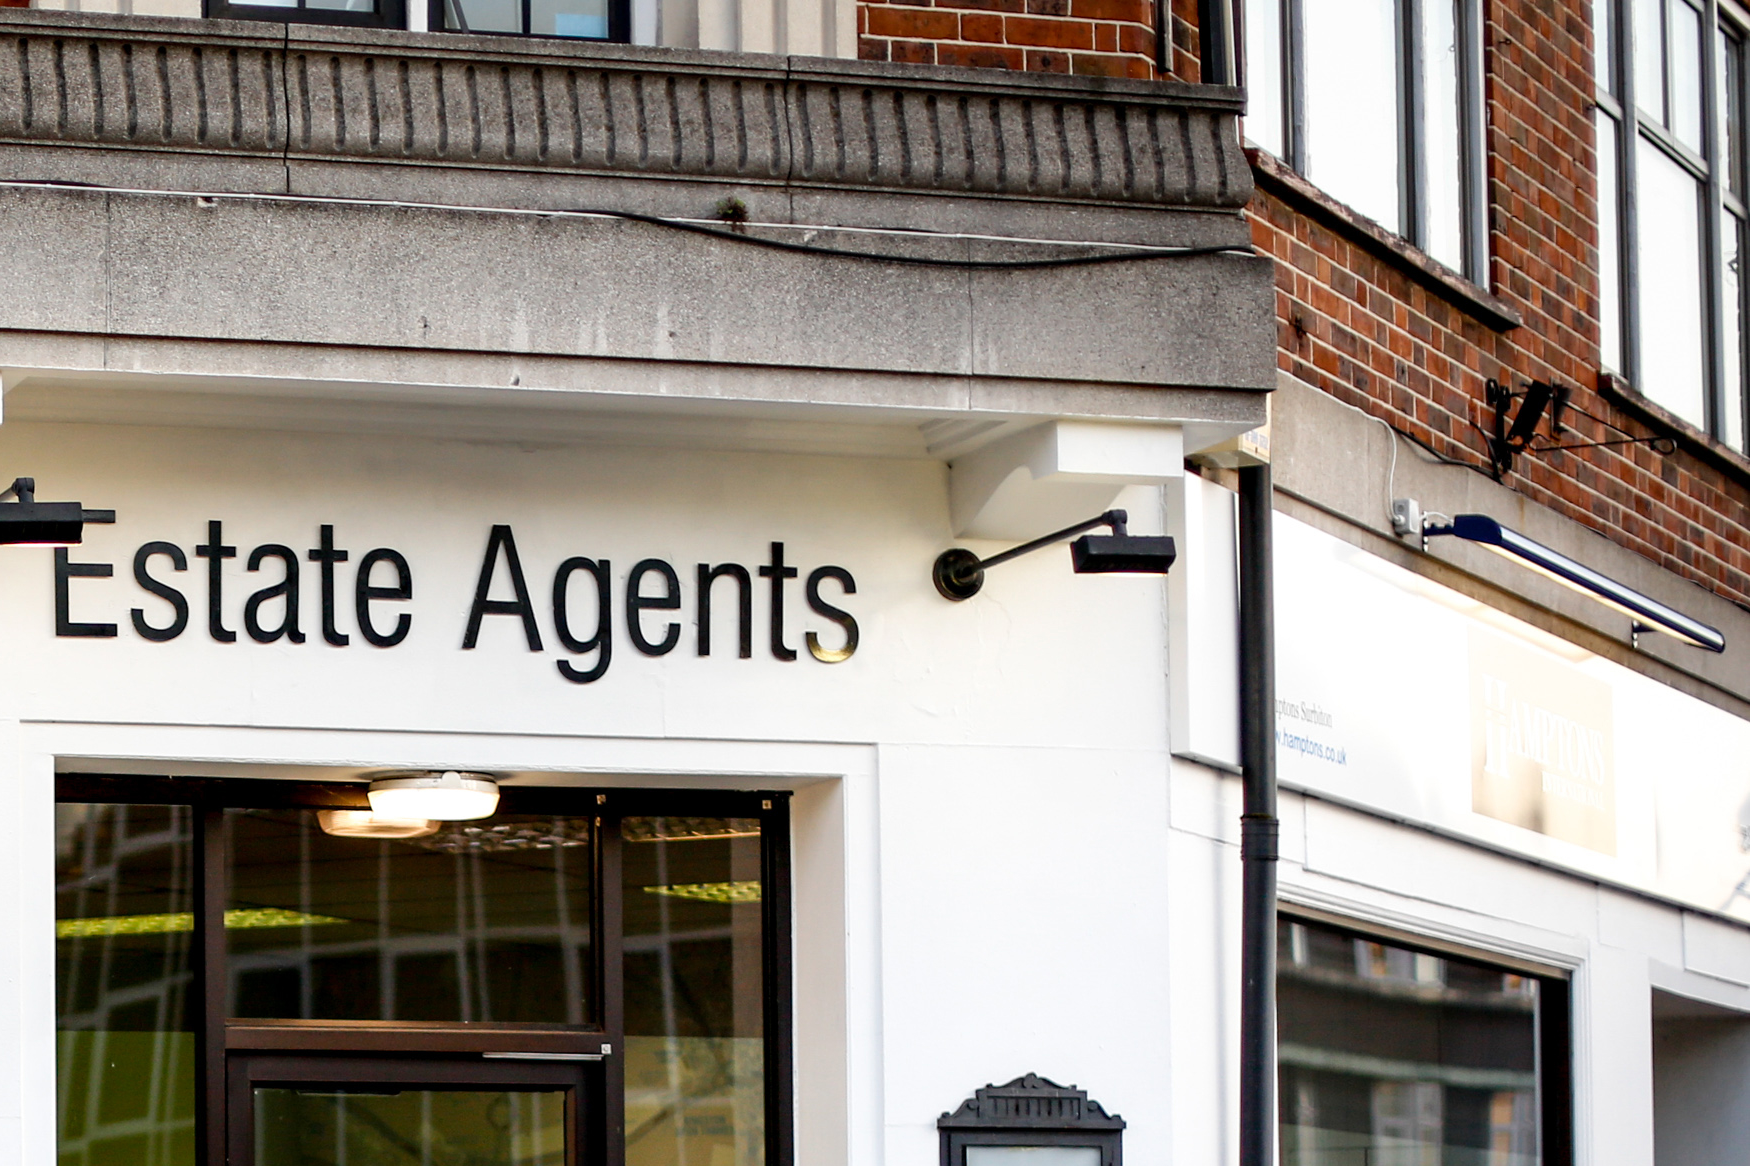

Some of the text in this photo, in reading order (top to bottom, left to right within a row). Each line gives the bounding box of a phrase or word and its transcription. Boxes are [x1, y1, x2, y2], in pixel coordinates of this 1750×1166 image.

[52, 508, 861, 685] Estate Agents
[1275, 728, 1348, 767] w.hamptons.co.uk
